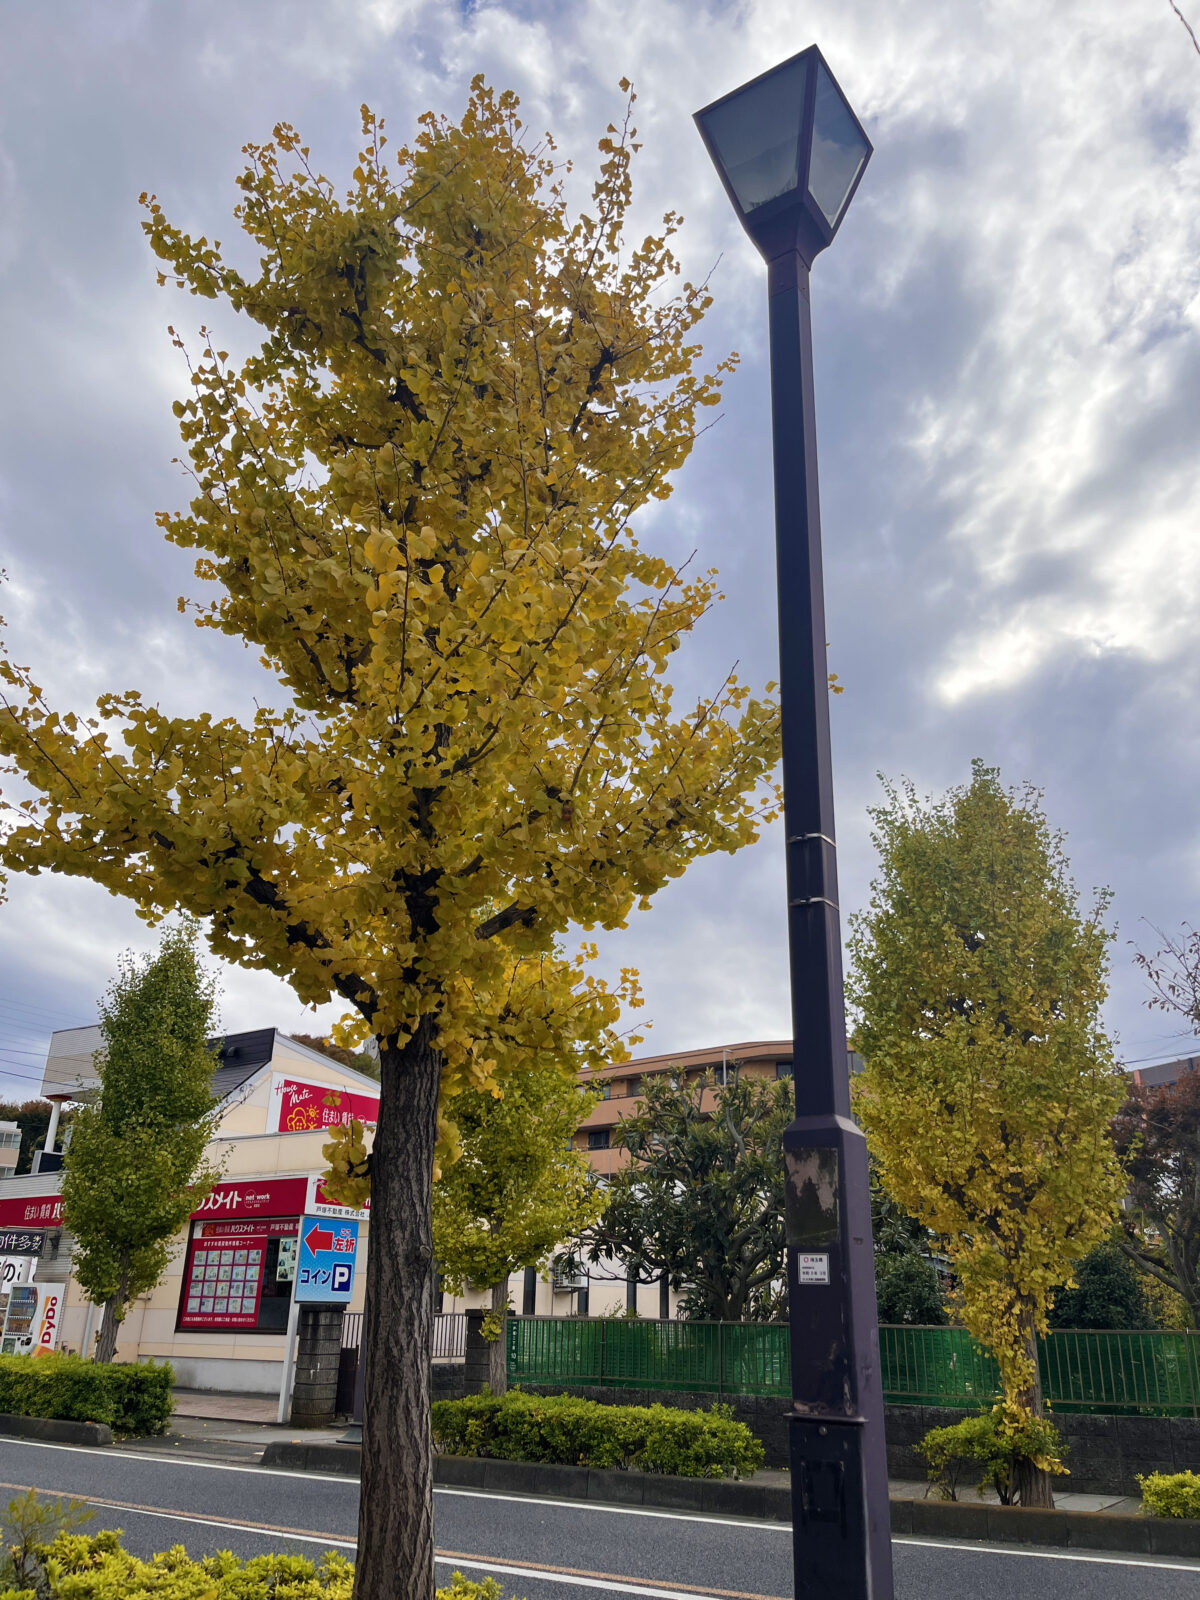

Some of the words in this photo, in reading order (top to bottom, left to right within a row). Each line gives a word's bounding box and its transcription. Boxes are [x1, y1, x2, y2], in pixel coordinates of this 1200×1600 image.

[275, 1081, 298, 1096] House
[290, 1089, 313, 1107] Mate
[333, 1237, 355, 1253] 左折
[300, 1269, 331, 1285] コイン
[333, 1266, 349, 1289] P
[41, 1296, 58, 1344] DyDo
